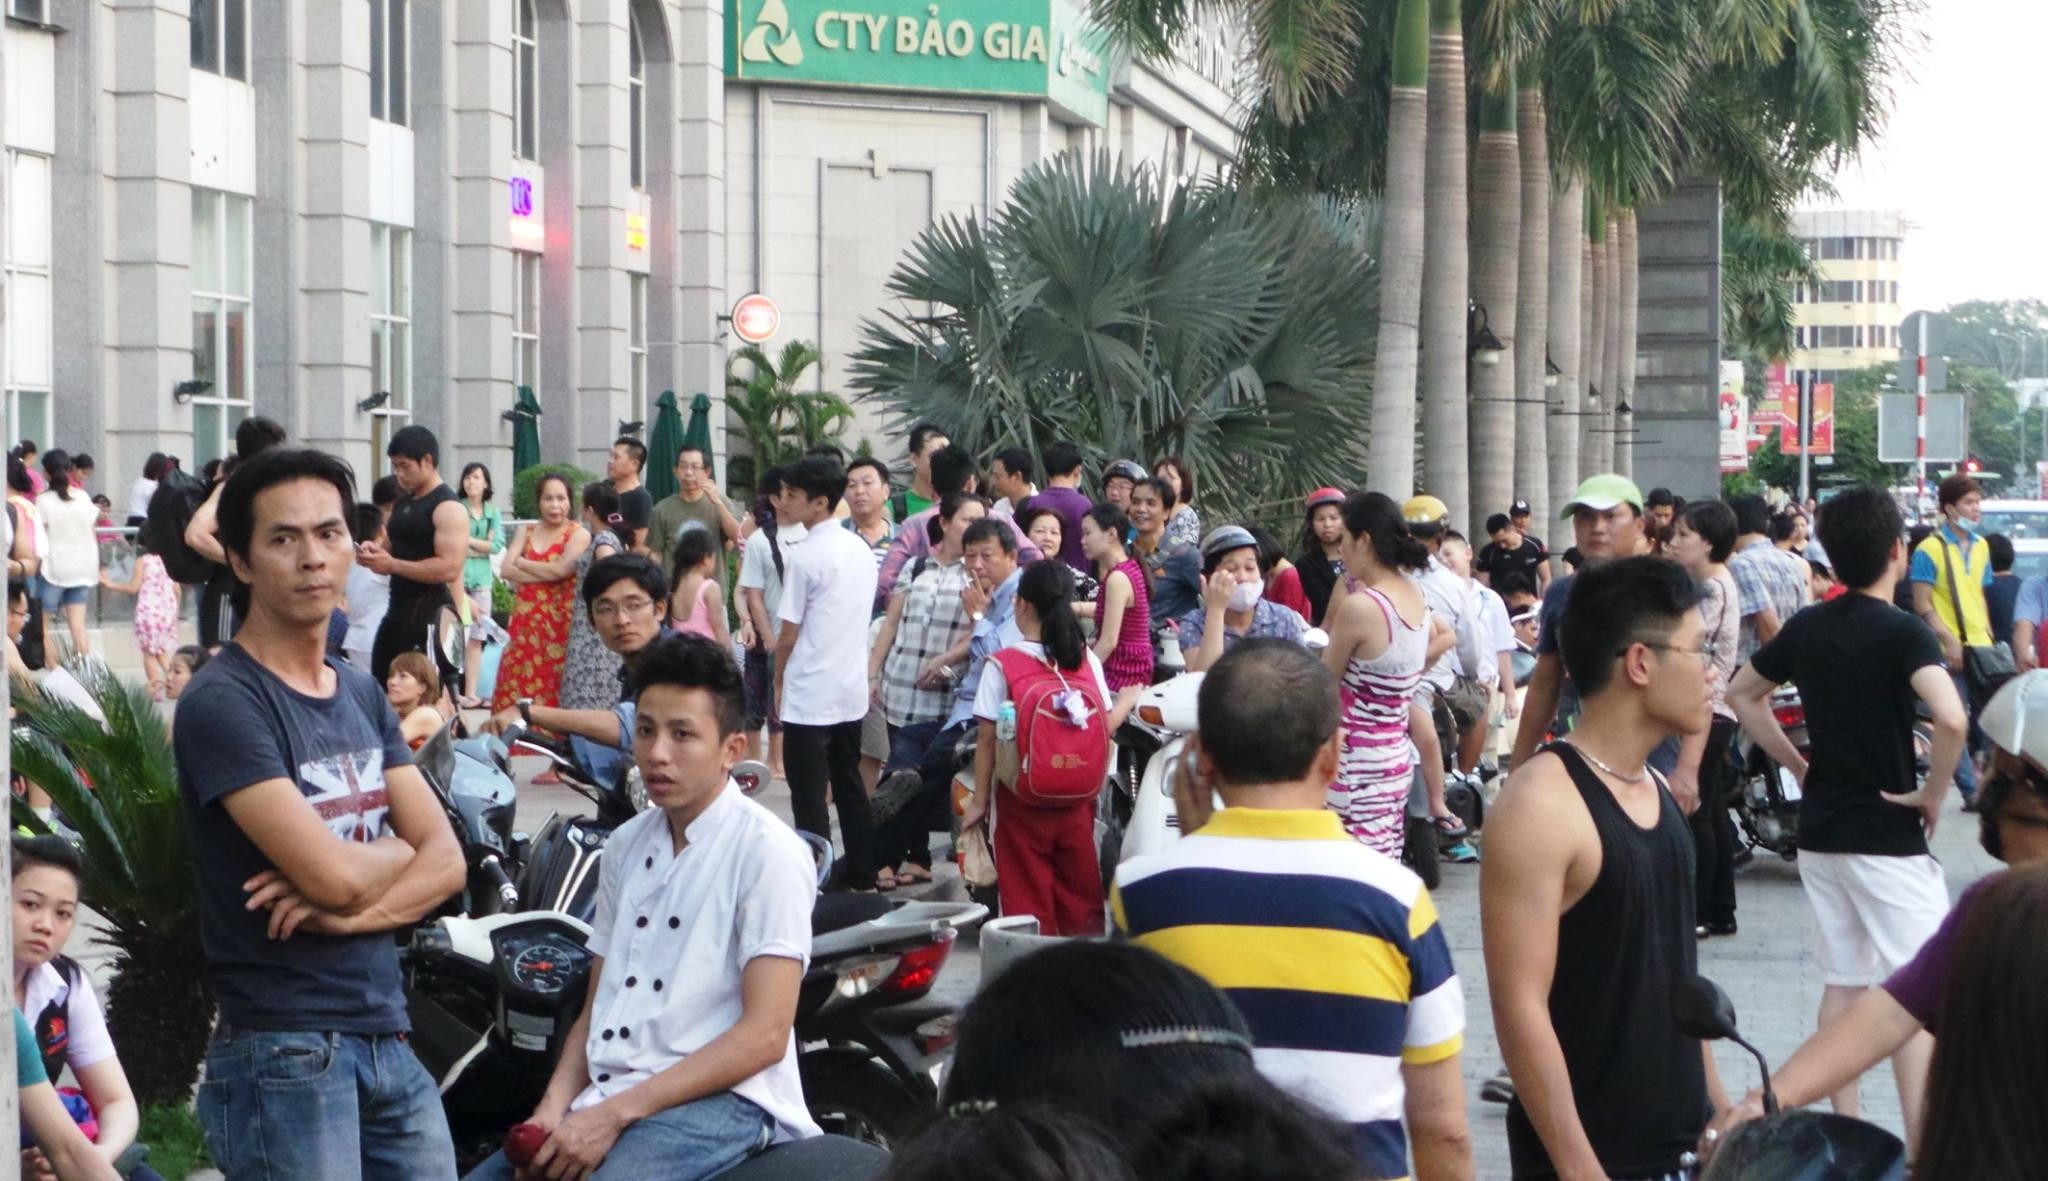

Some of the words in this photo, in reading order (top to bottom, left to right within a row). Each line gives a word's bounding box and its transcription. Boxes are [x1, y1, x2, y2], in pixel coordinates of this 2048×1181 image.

[815, 10, 888, 51] CTY
[896, 4, 974, 58] BẢO
[983, 22, 1048, 62] GIA
